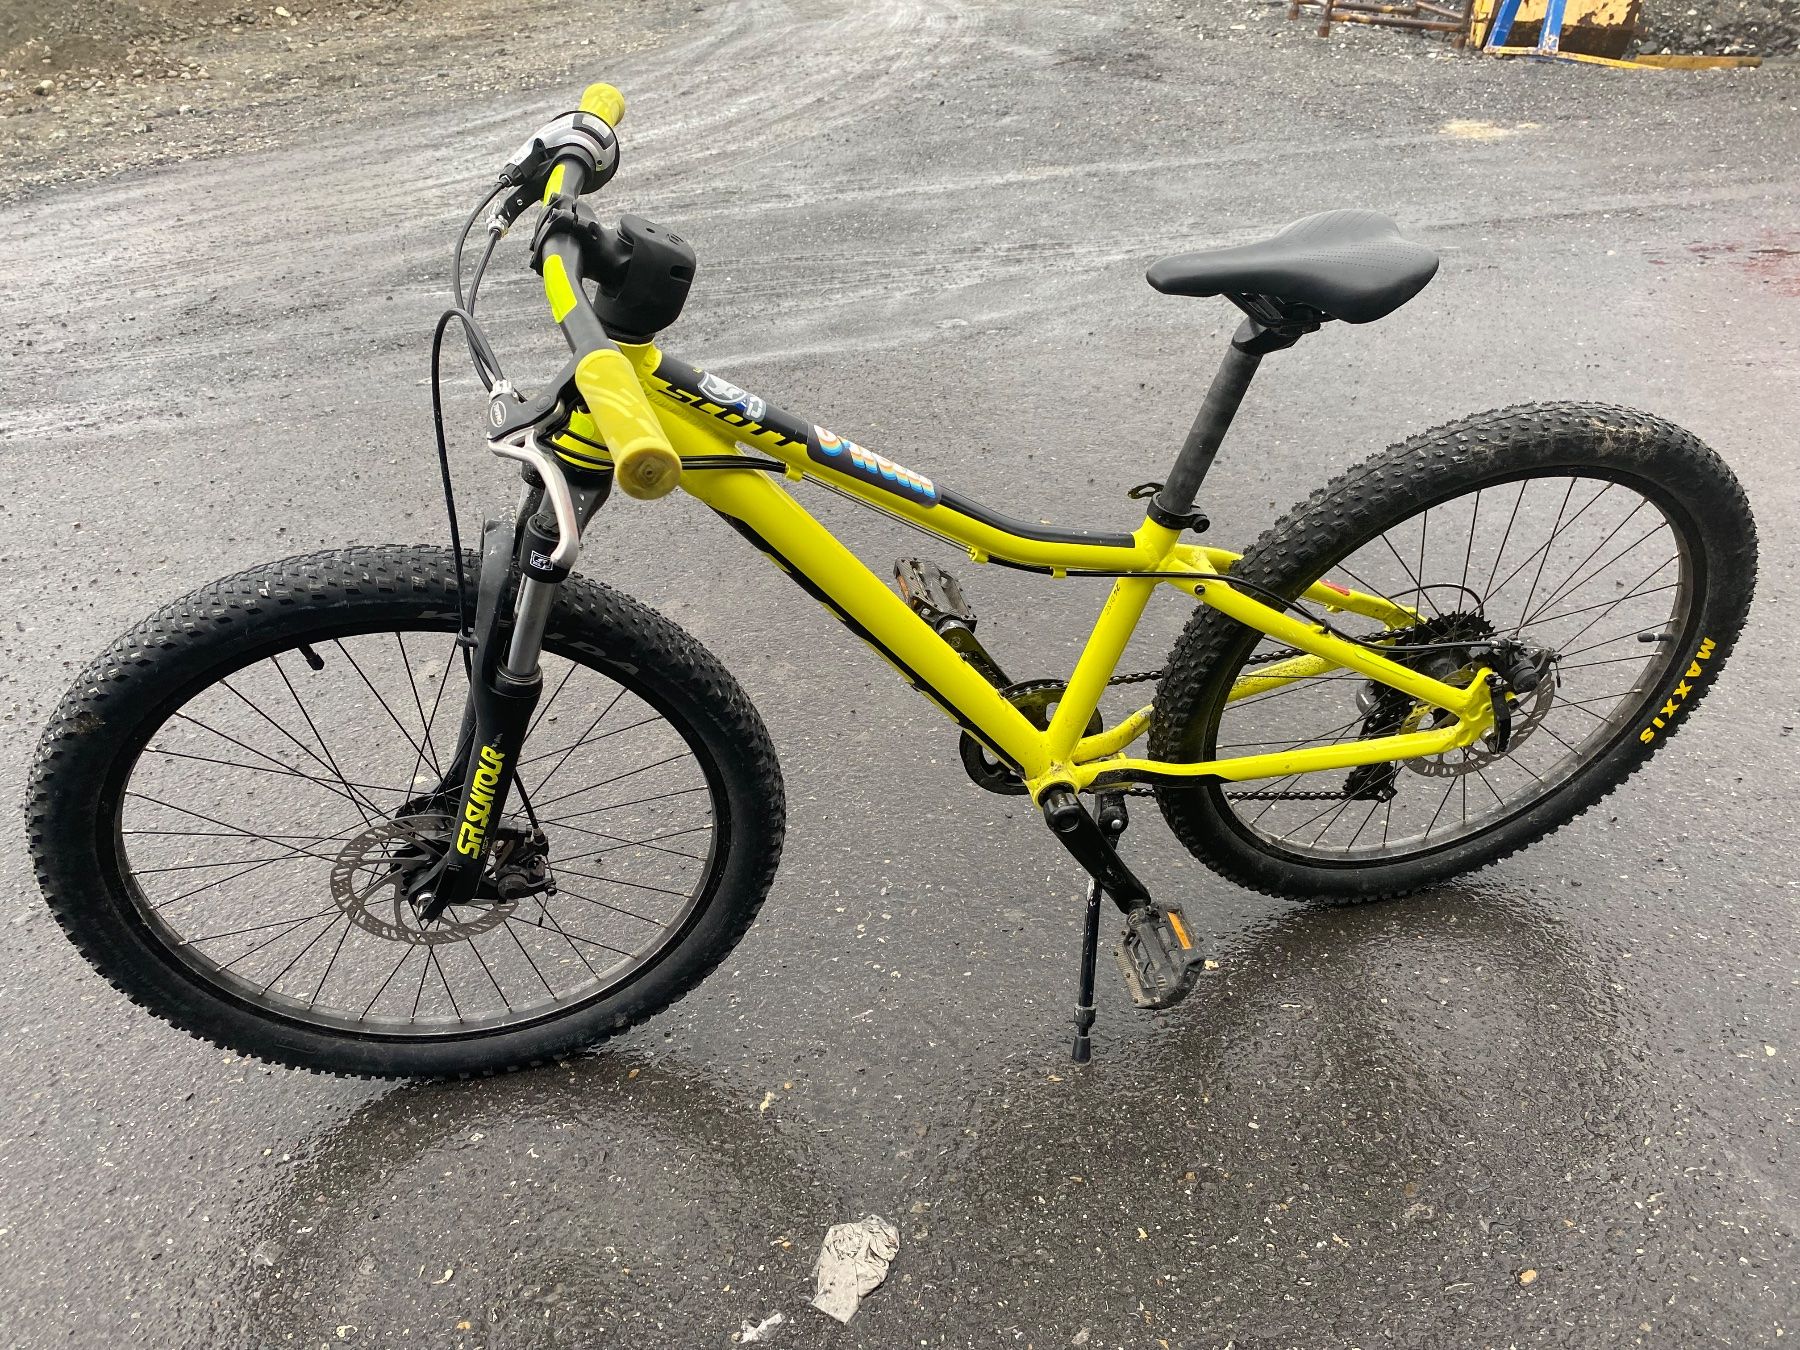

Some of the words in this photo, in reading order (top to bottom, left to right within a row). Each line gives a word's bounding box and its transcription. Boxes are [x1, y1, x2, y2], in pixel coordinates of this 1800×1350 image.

[656, 383, 807, 447] SCOTT
[1639, 636, 1717, 744] MAXXIS
[465, 745, 506, 828] SUNTOUR
